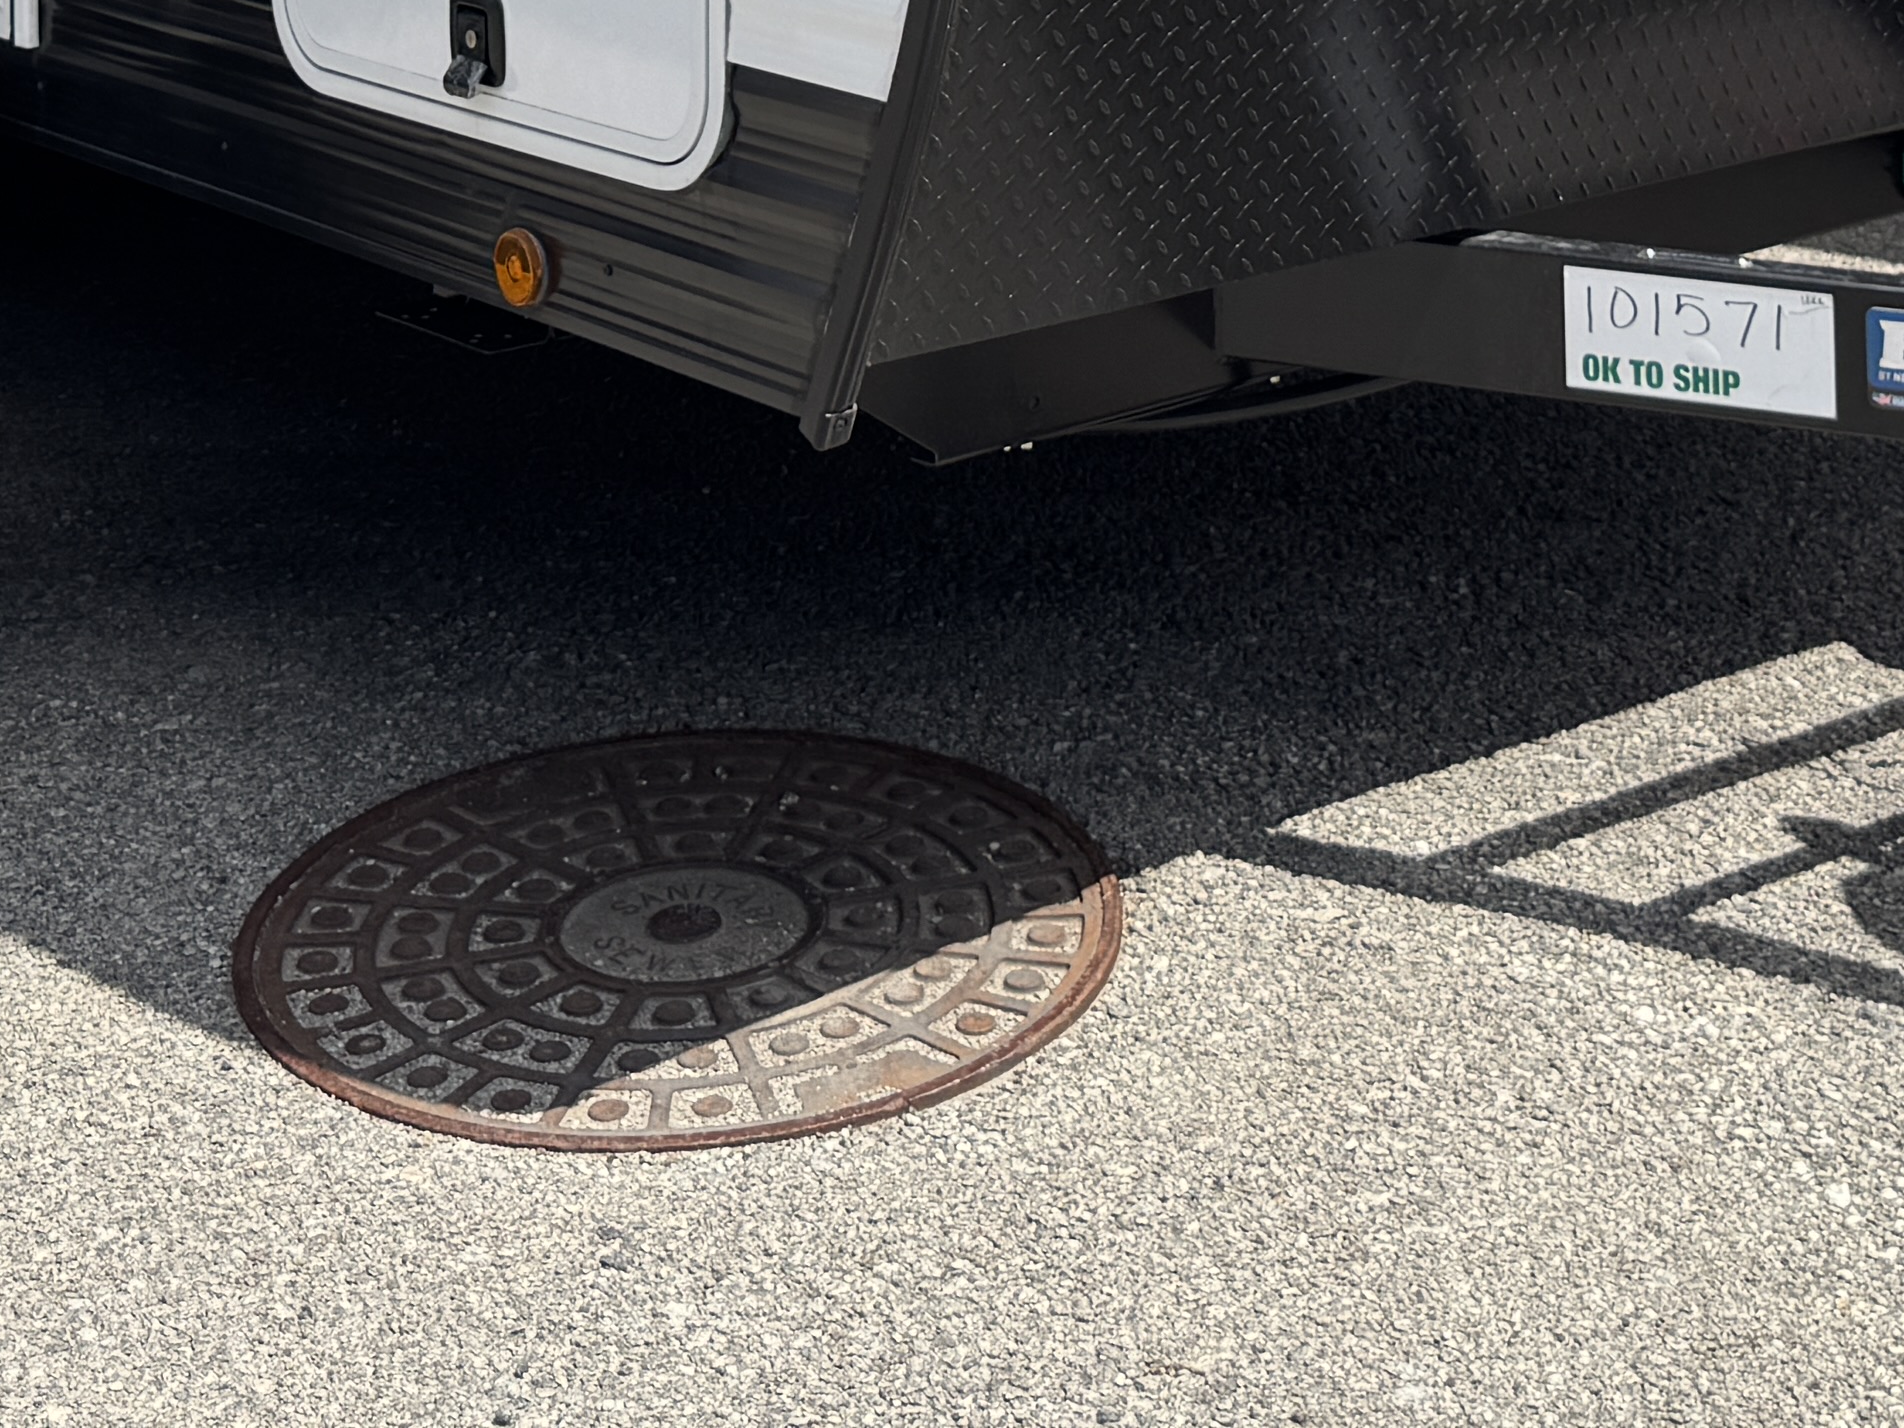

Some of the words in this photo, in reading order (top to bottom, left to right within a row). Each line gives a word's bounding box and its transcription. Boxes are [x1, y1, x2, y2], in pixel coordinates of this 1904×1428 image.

[1586, 285, 1783, 351] 101571
[1582, 353, 1622, 384] OK
[1629, 359, 1664, 389] TO
[1673, 364, 1741, 396] SHIP
